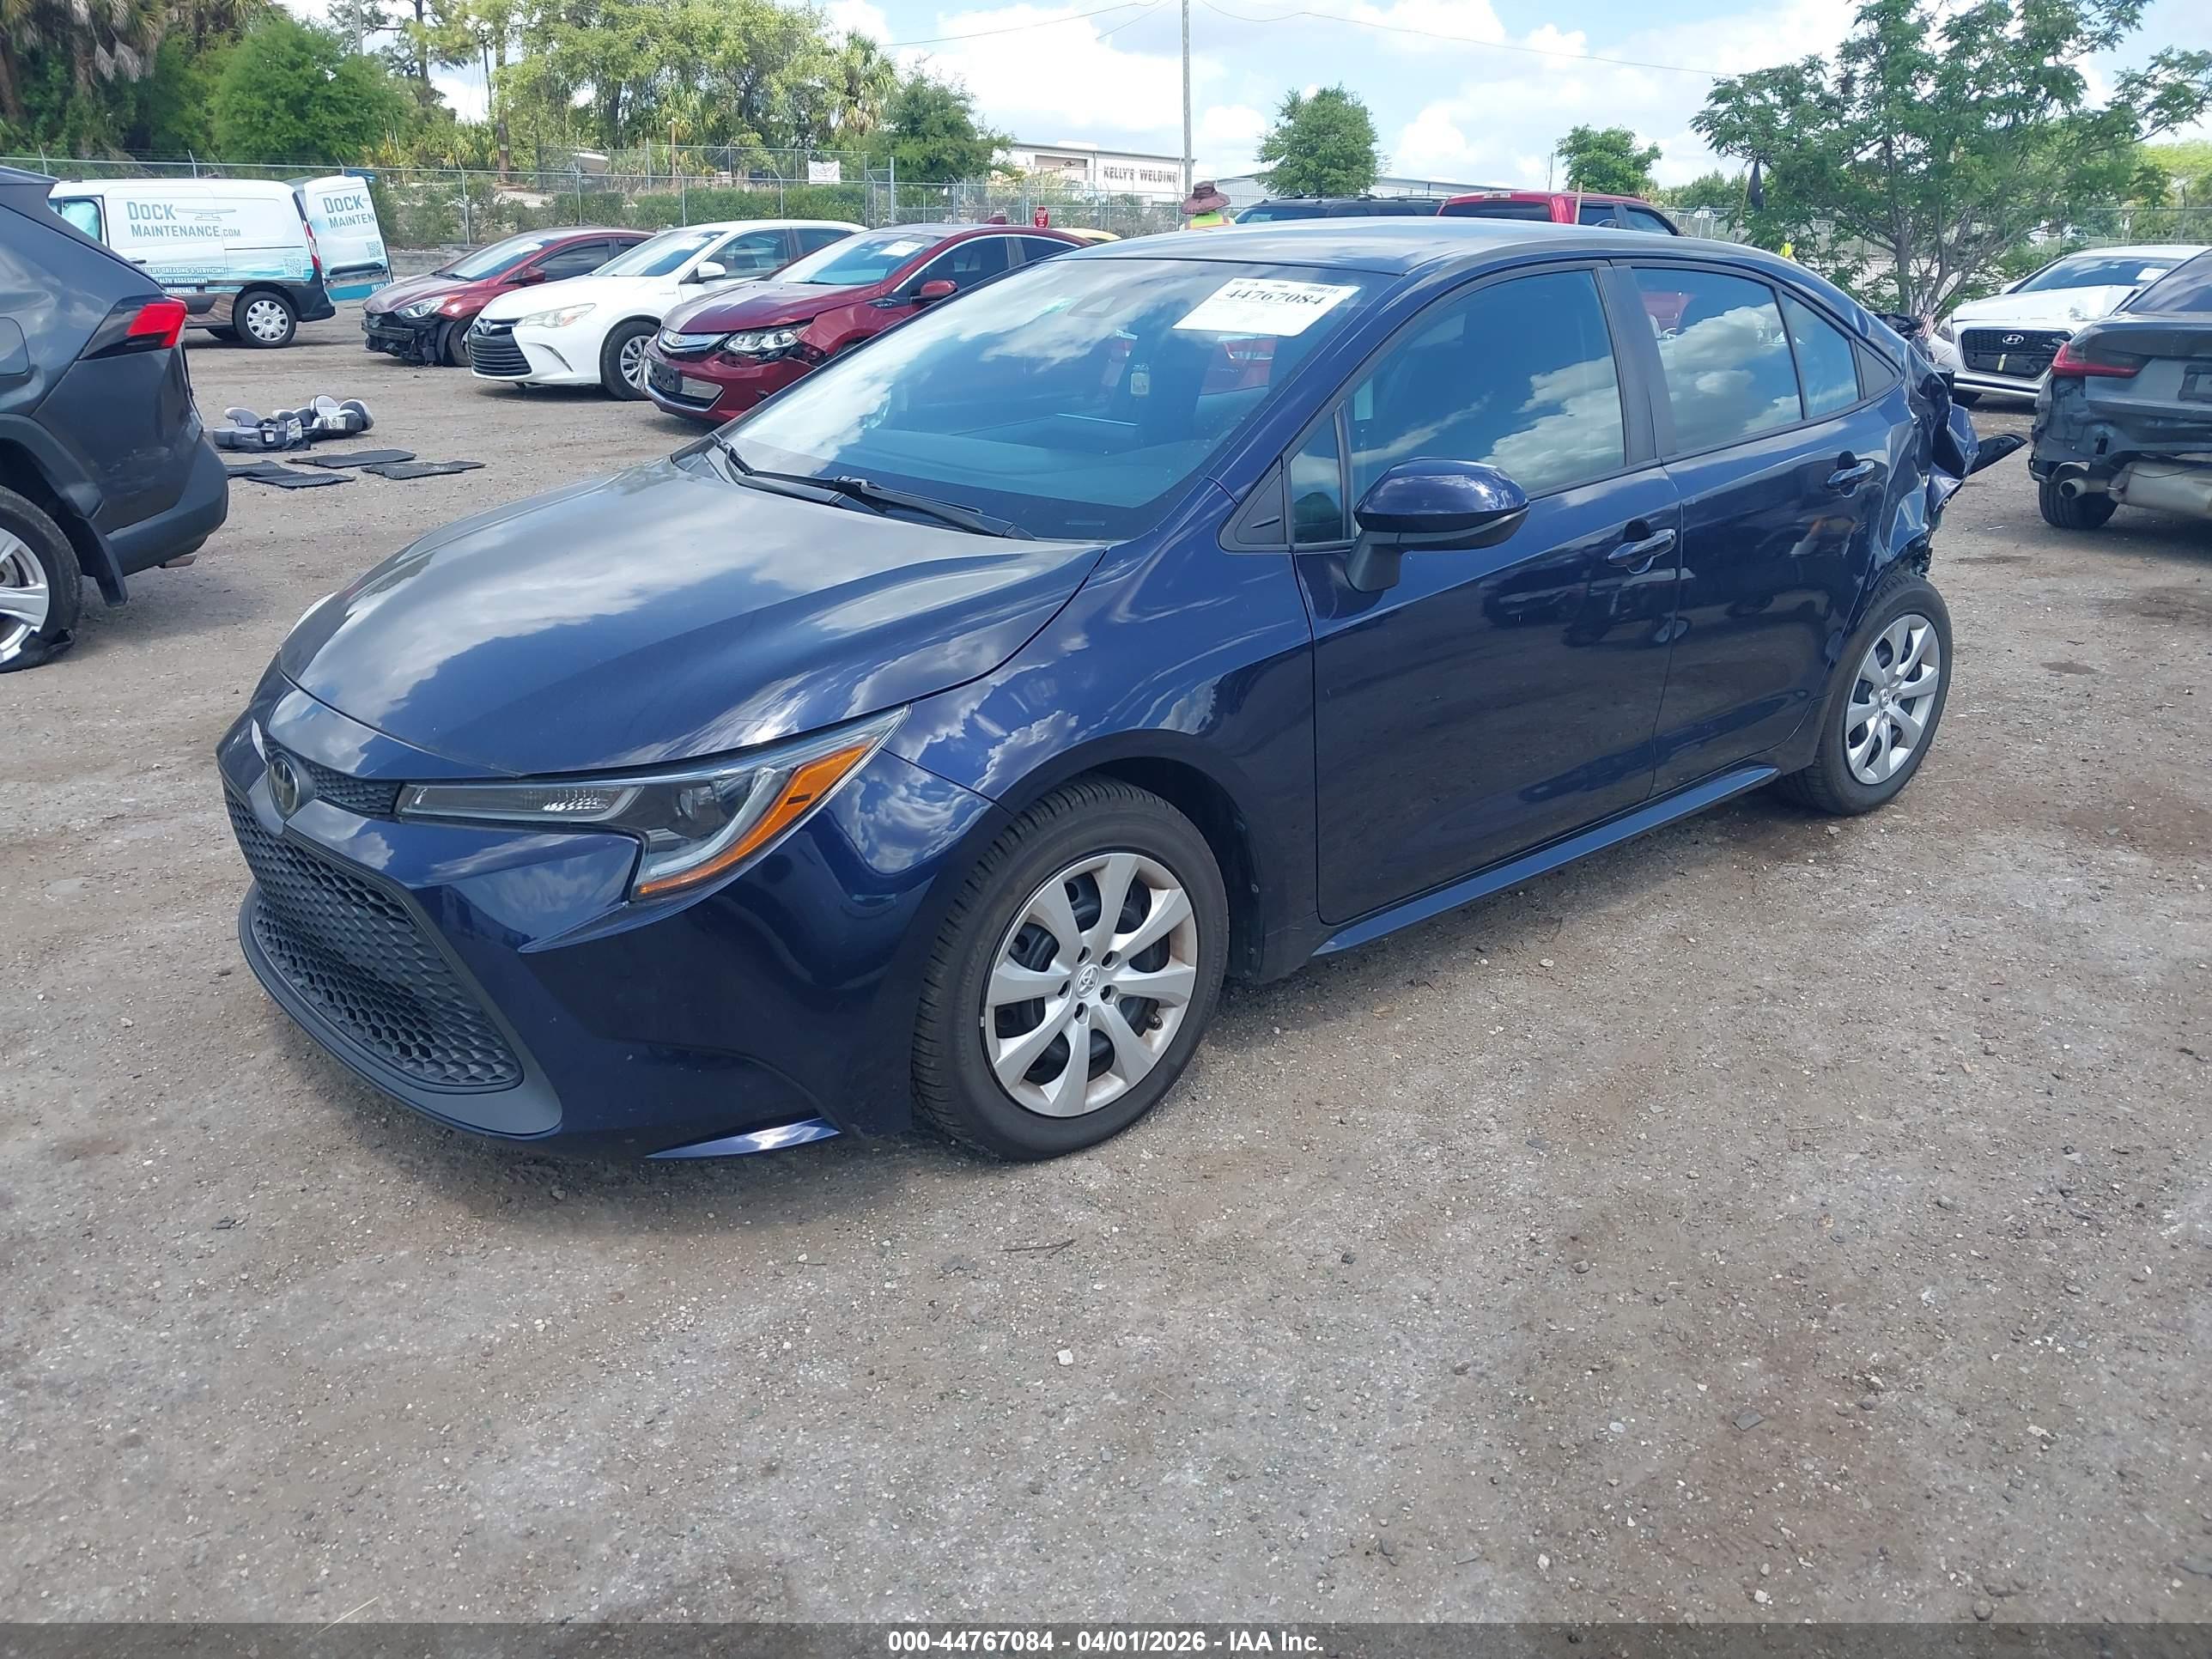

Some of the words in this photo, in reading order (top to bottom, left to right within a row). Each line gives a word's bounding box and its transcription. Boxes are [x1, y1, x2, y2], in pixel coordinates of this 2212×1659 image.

[1103, 165, 1135, 180] KELLY'S
[1139, 168, 1178, 183] WELDING
[126, 201, 177, 220] DOCK
[322, 194, 364, 214] DOCK
[1036, 210, 1048, 219] STOP
[1225, 289, 1328, 305] 44767084
